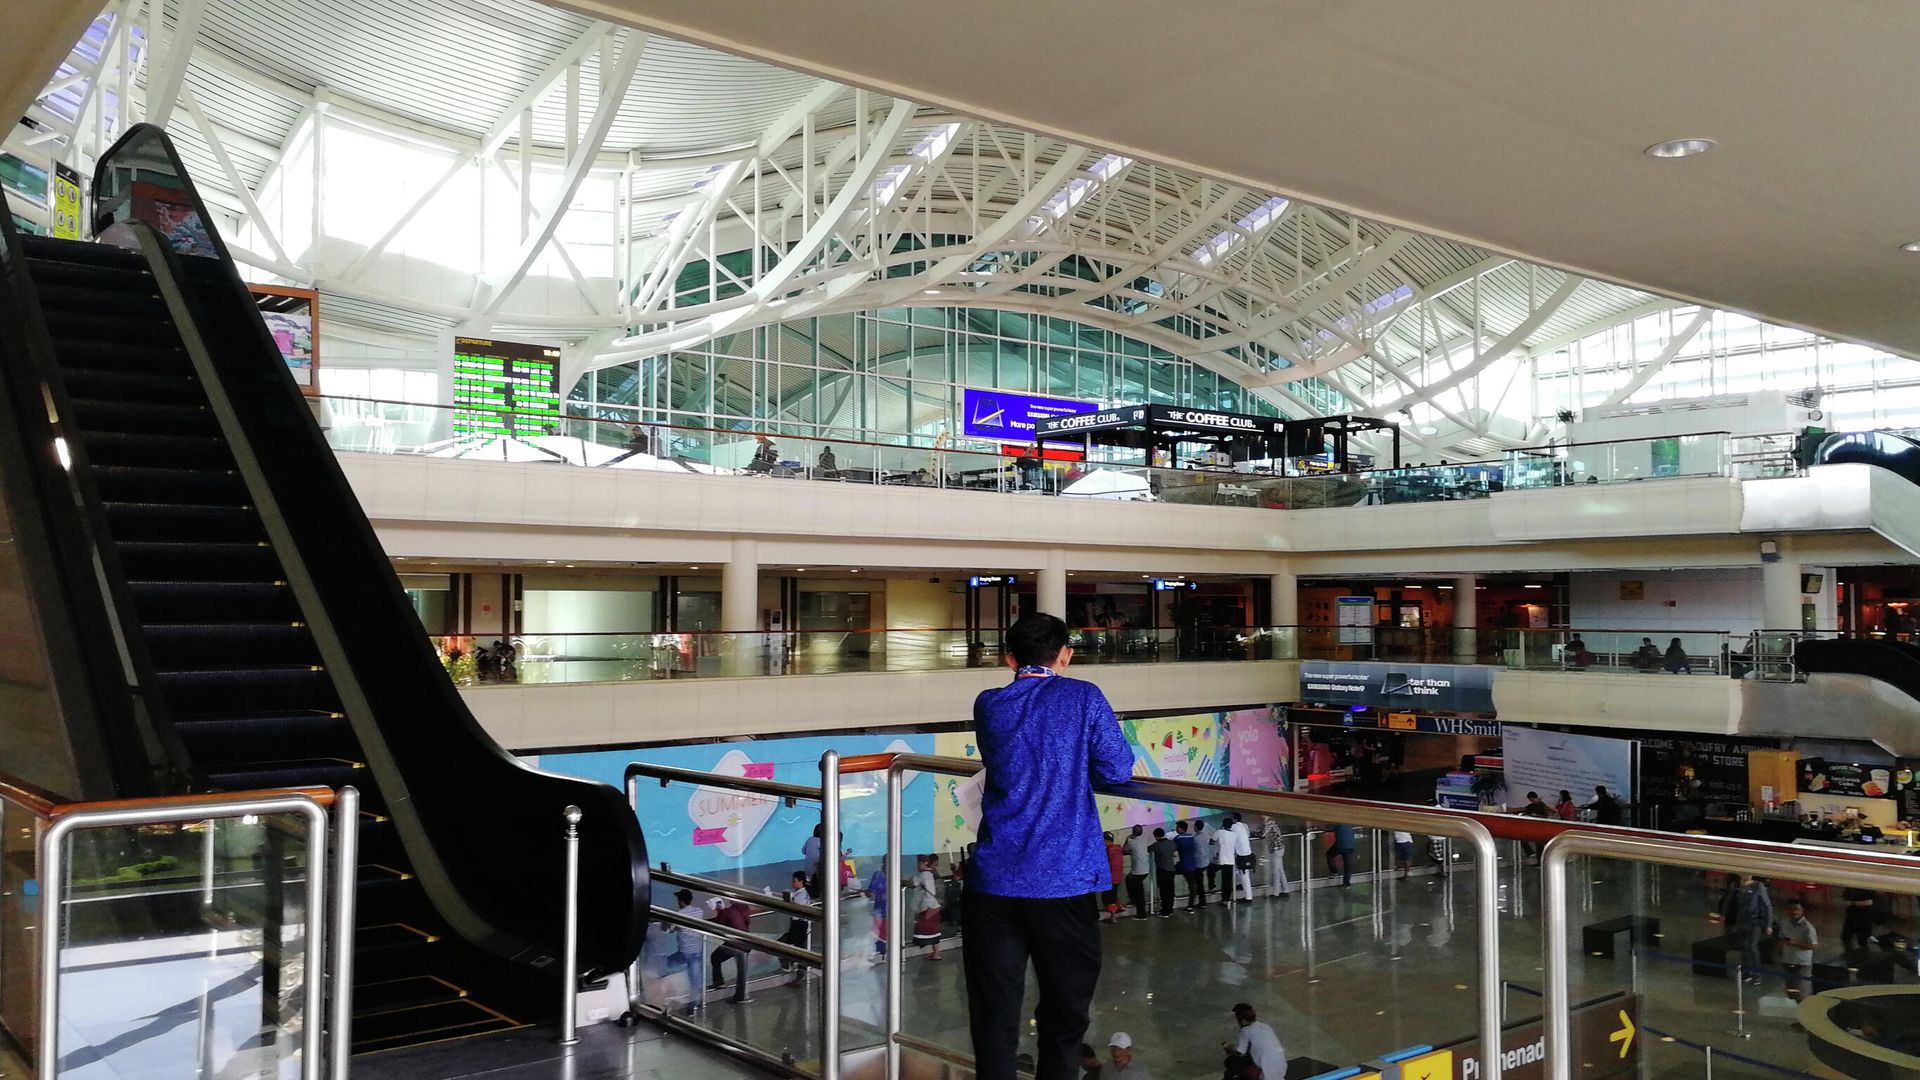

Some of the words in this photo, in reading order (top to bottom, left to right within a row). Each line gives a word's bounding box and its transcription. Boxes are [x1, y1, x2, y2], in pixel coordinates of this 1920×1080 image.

[1010, 420, 1026, 429] More
[1046, 419, 1060, 430] THE
[1060, 414, 1097, 429] COFFEE
[1097, 413, 1117, 425] CLUB
[1167, 411, 1185, 420] THE
[1186, 412, 1230, 426] COFFEE
[1230, 418, 1253, 428] CLUB
[1409, 678, 1425, 686] ter
[1427, 678, 1451, 687] than
[1414, 687, 1439, 695] think
[1237, 724, 1259, 748] yolo
[1636, 739, 1674, 750] ELCOME
[1713, 756, 1744, 767] STORE
